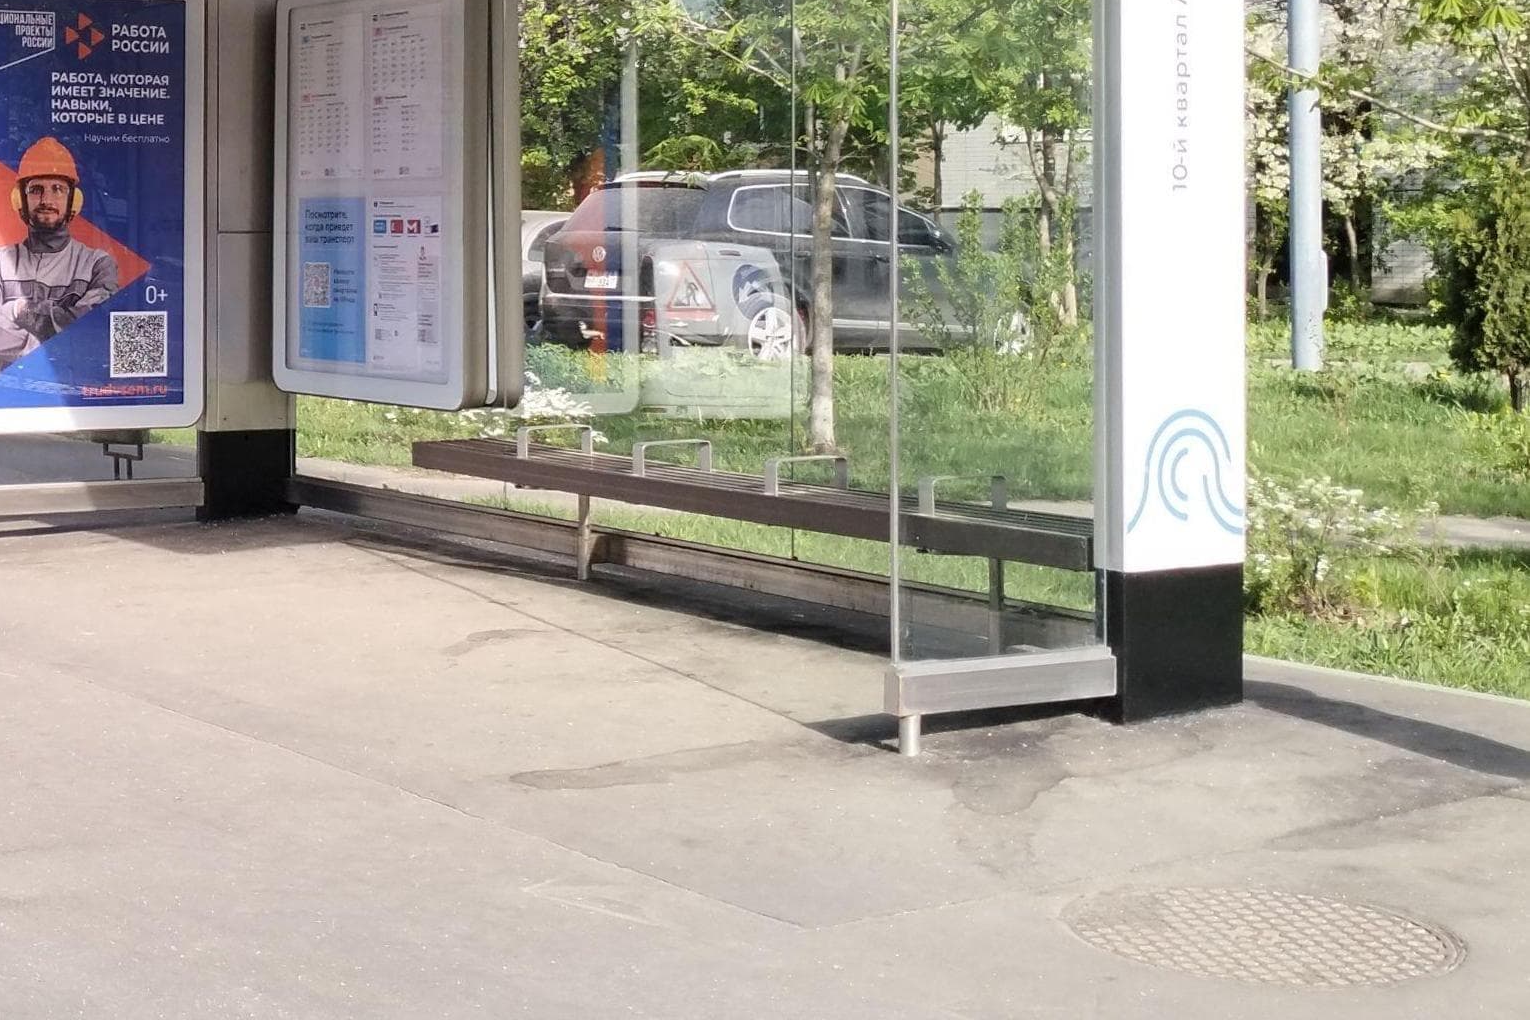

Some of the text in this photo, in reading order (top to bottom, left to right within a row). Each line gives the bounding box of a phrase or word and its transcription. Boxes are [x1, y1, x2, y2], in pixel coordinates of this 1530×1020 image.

[15, 24, 53, 36] ПРОЕКТЫ
[111, 24, 167, 38] РАБОТА
[21, 36, 53, 48] РОССИИ
[111, 39, 170, 54] РОССИИ
[1176, 15, 1190, 128] квартал
[51, 72, 169, 86] РАБОТА, КОТОРАЯ
[51, 85, 170, 99] ИМЕЕТ ЗНАЧЕНИЕ.
[51, 98, 112, 112] НАВЫКИ,
[51, 112, 165, 126] КОТОРЫЕ В ЦЕНЕ
[84, 133, 170, 145] Научим бесплатно
[1172, 139, 1188, 191] 10-й
[145, 285, 169, 304] 0+
